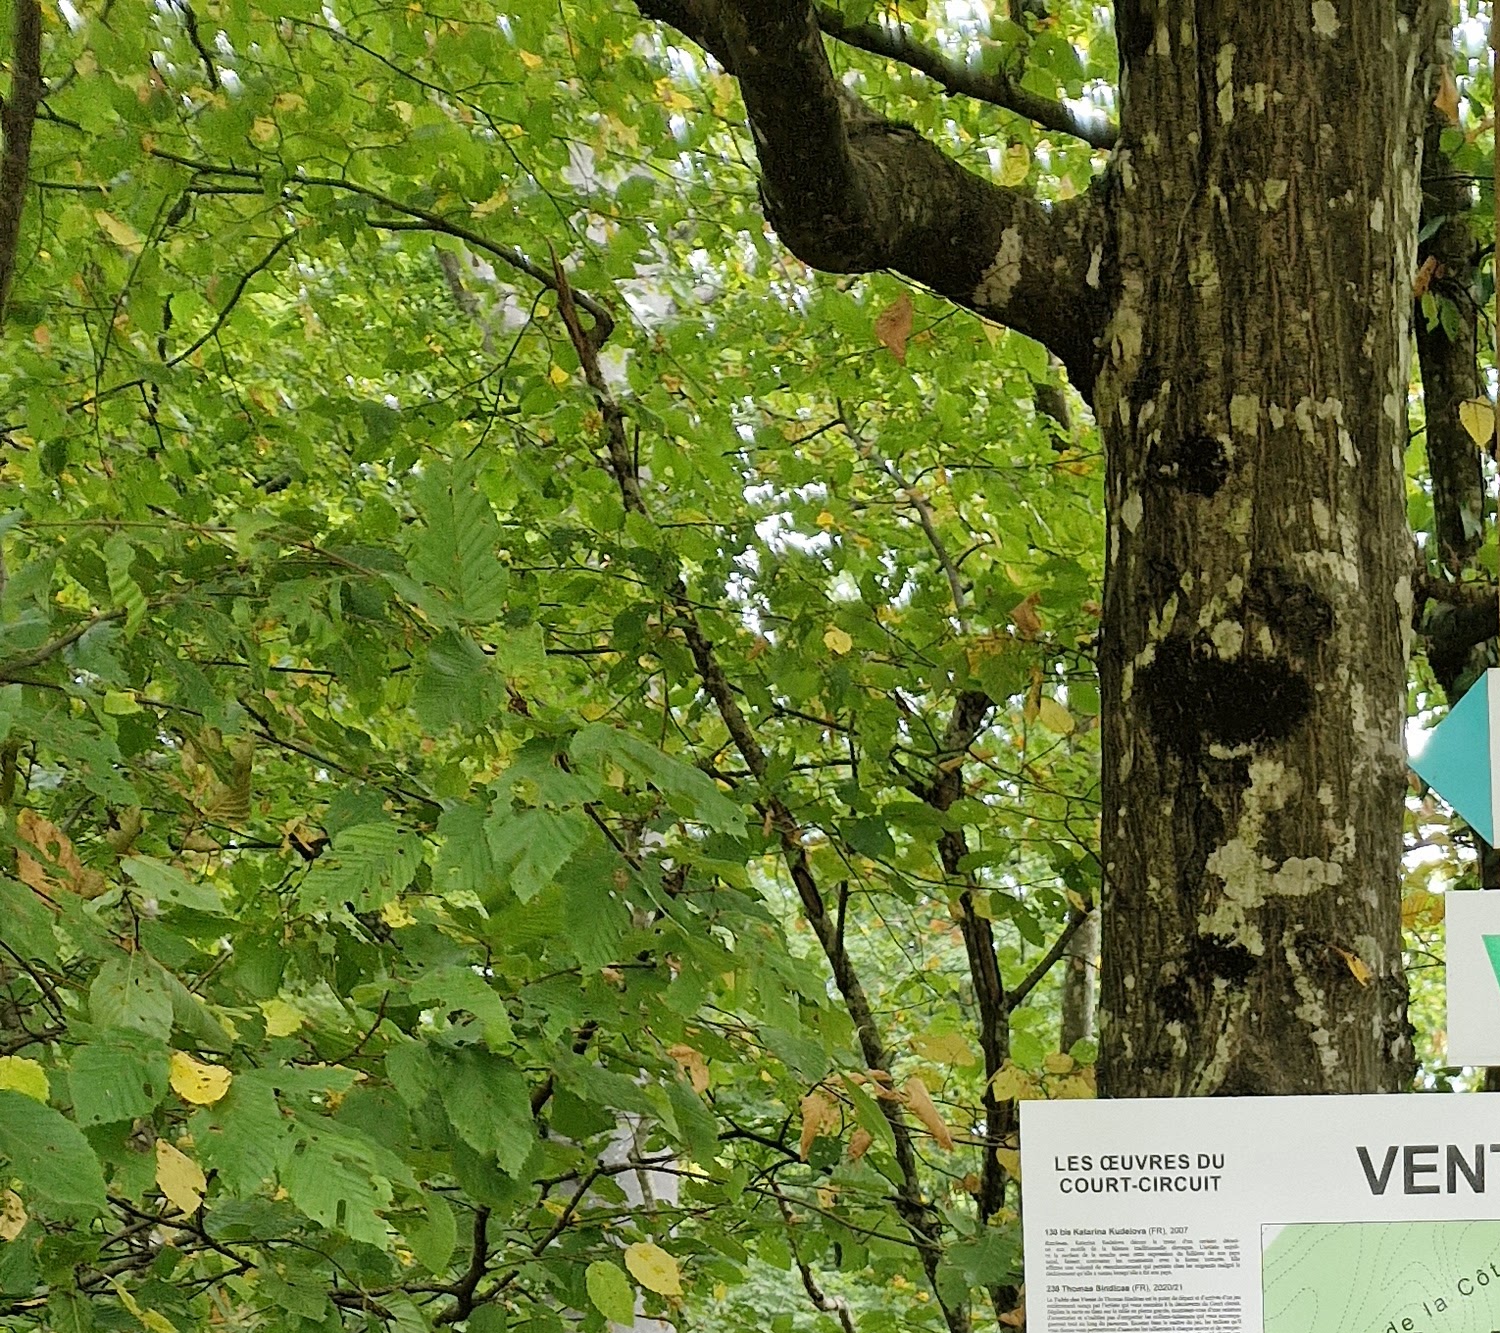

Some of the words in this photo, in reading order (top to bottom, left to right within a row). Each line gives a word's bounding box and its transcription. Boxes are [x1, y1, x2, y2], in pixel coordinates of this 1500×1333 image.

[1055, 1156, 1093, 1172] LES
[1100, 1154, 1190, 1171] ŒUVRES
[1198, 1153, 1224, 1169] DU
[1060, 1176, 1222, 1193] COURT-CIRCUIT
[1422, 1297, 1448, 1317] la
